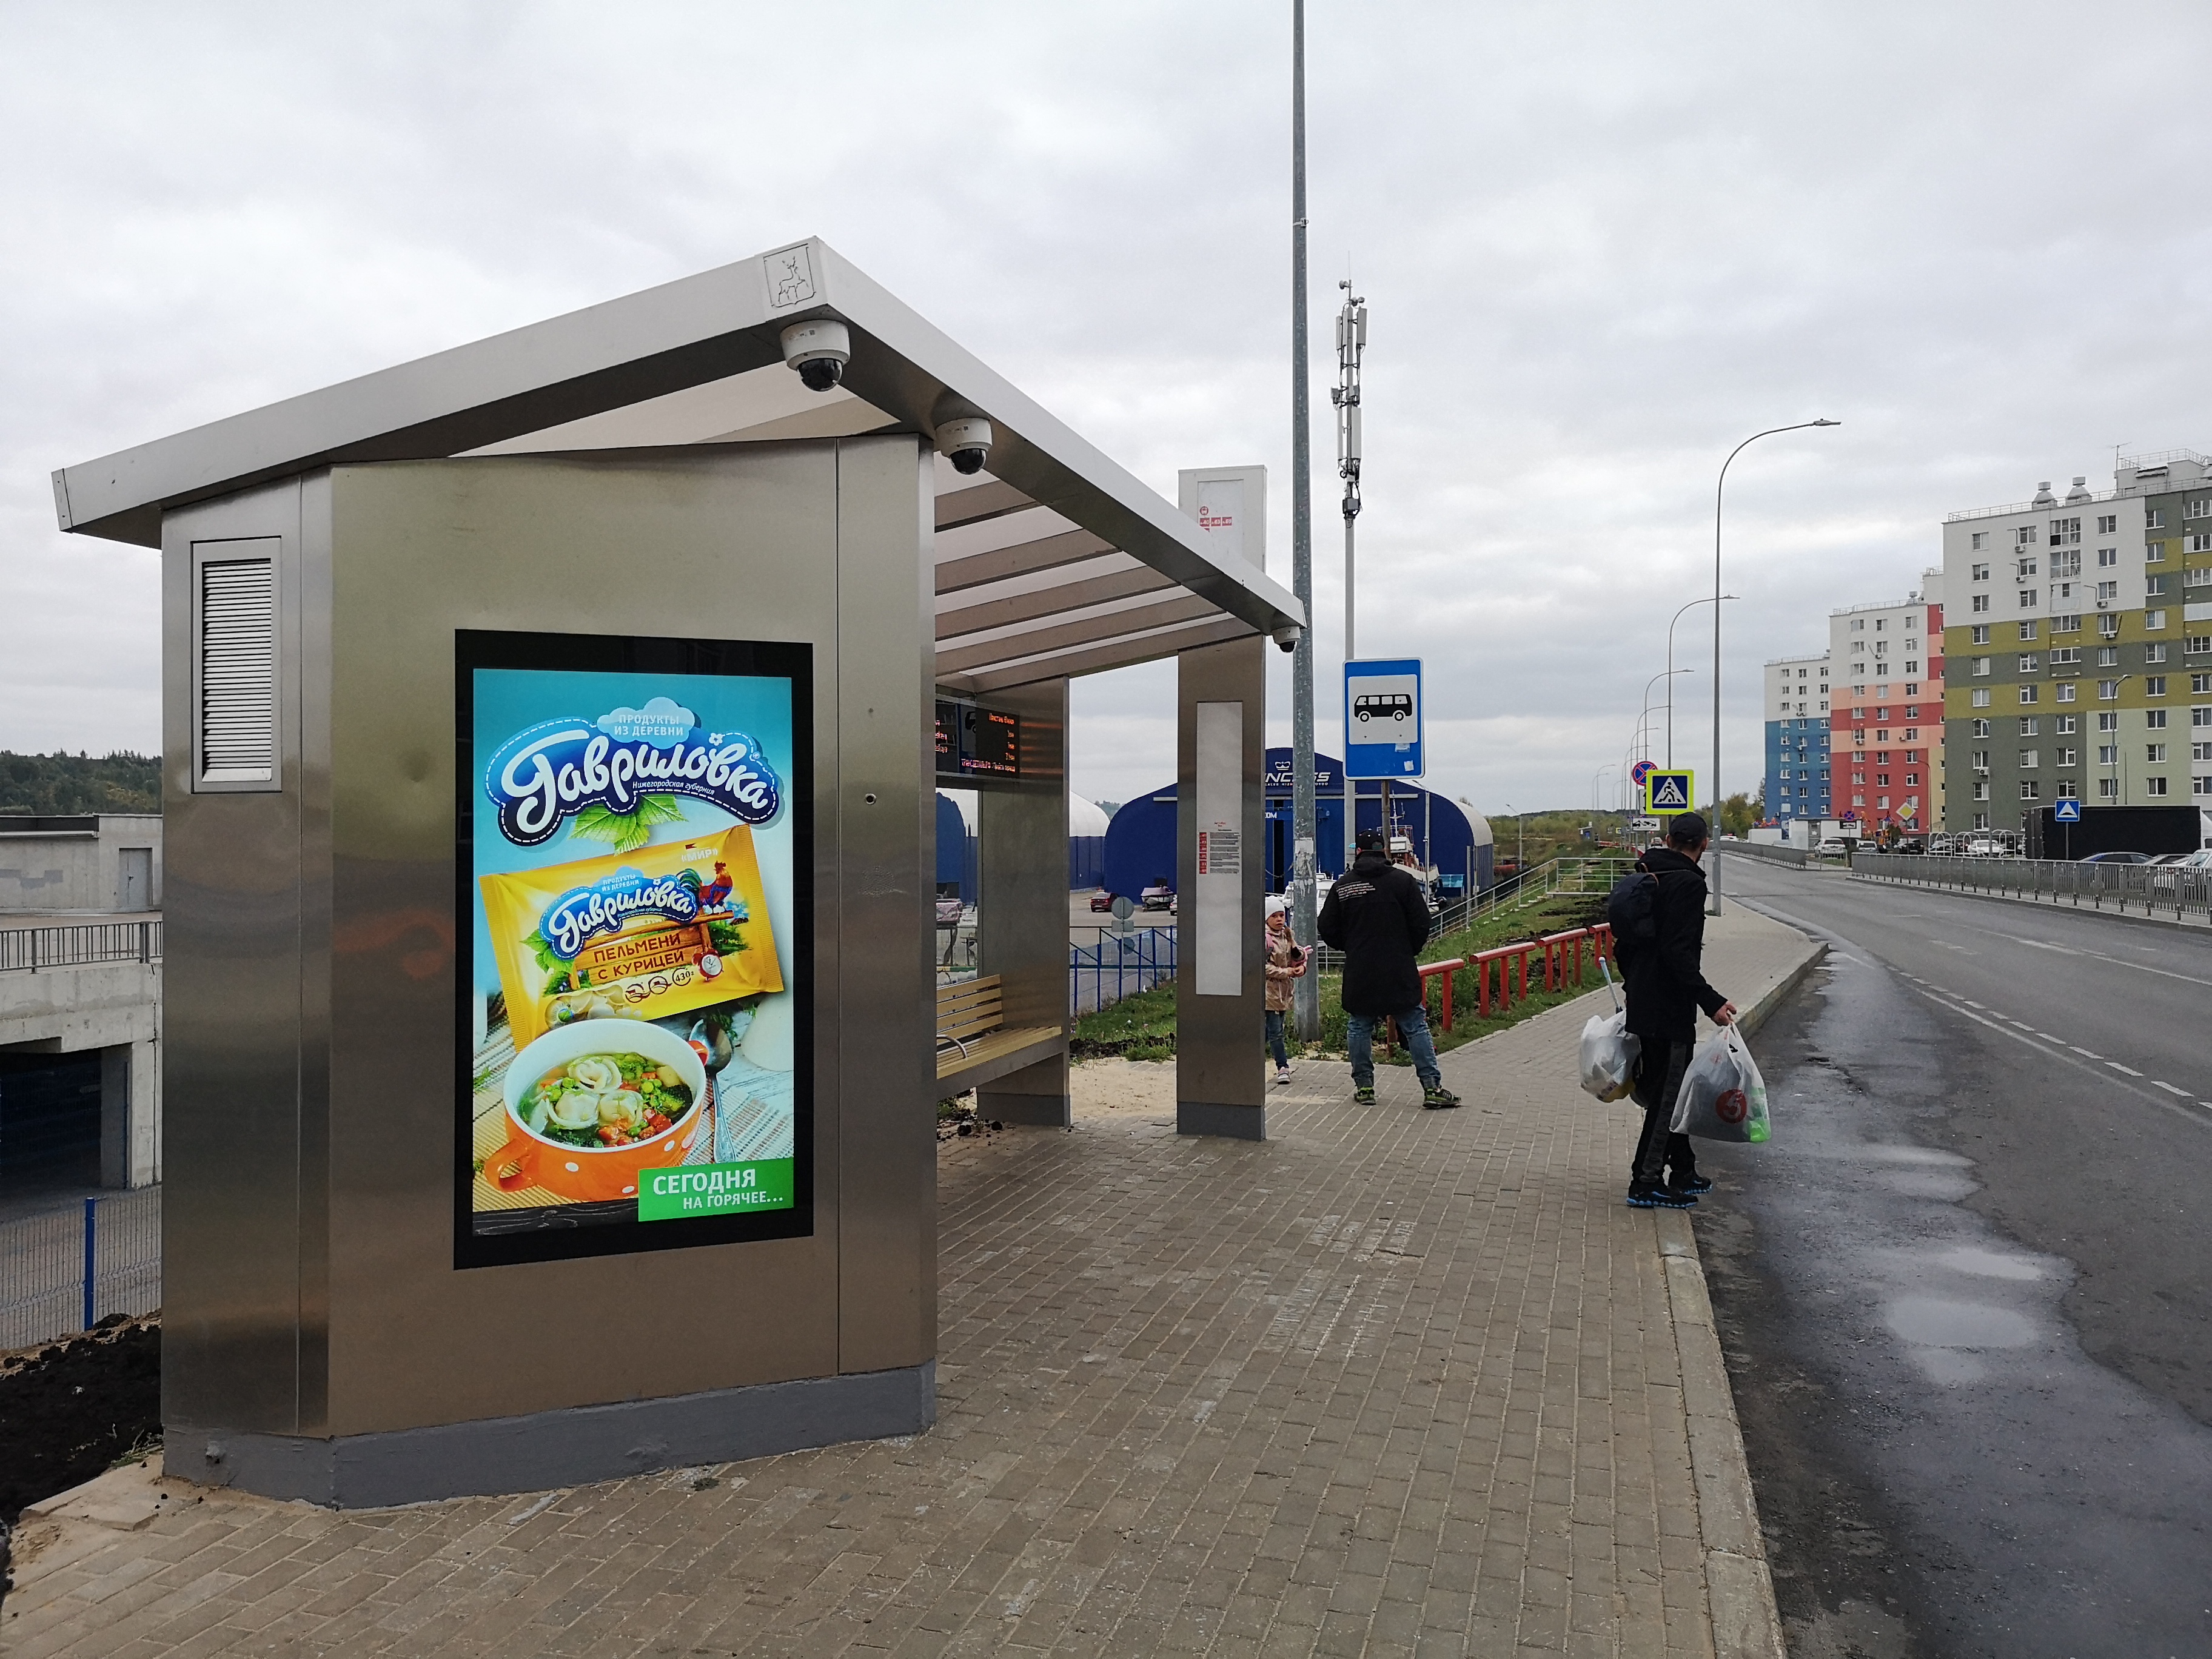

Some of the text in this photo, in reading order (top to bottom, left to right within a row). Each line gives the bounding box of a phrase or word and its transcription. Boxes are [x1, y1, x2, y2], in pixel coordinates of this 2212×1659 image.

[618, 714, 679, 725] ПРОДУКТЫ
[614, 726, 683, 736] ИЗ ДЕРЕВНИ
[501, 729, 768, 834] Гавриловка
[632, 780, 715, 795] Нижегородская губерния
[603, 874, 636, 885] ПРОДУКТЫ
[611, 879, 640, 891] ДЕРЕВНИ
[549, 881, 692, 953] Гавриловка
[594, 933, 681, 963] ПЕЛЬМЕНИ
[598, 949, 684, 979] С КУРИЦЕЙ
[653, 1168, 756, 1195] СЕГОДНЯ
[683, 1191, 783, 1209] НА ГОРЯЧЕЕ...
